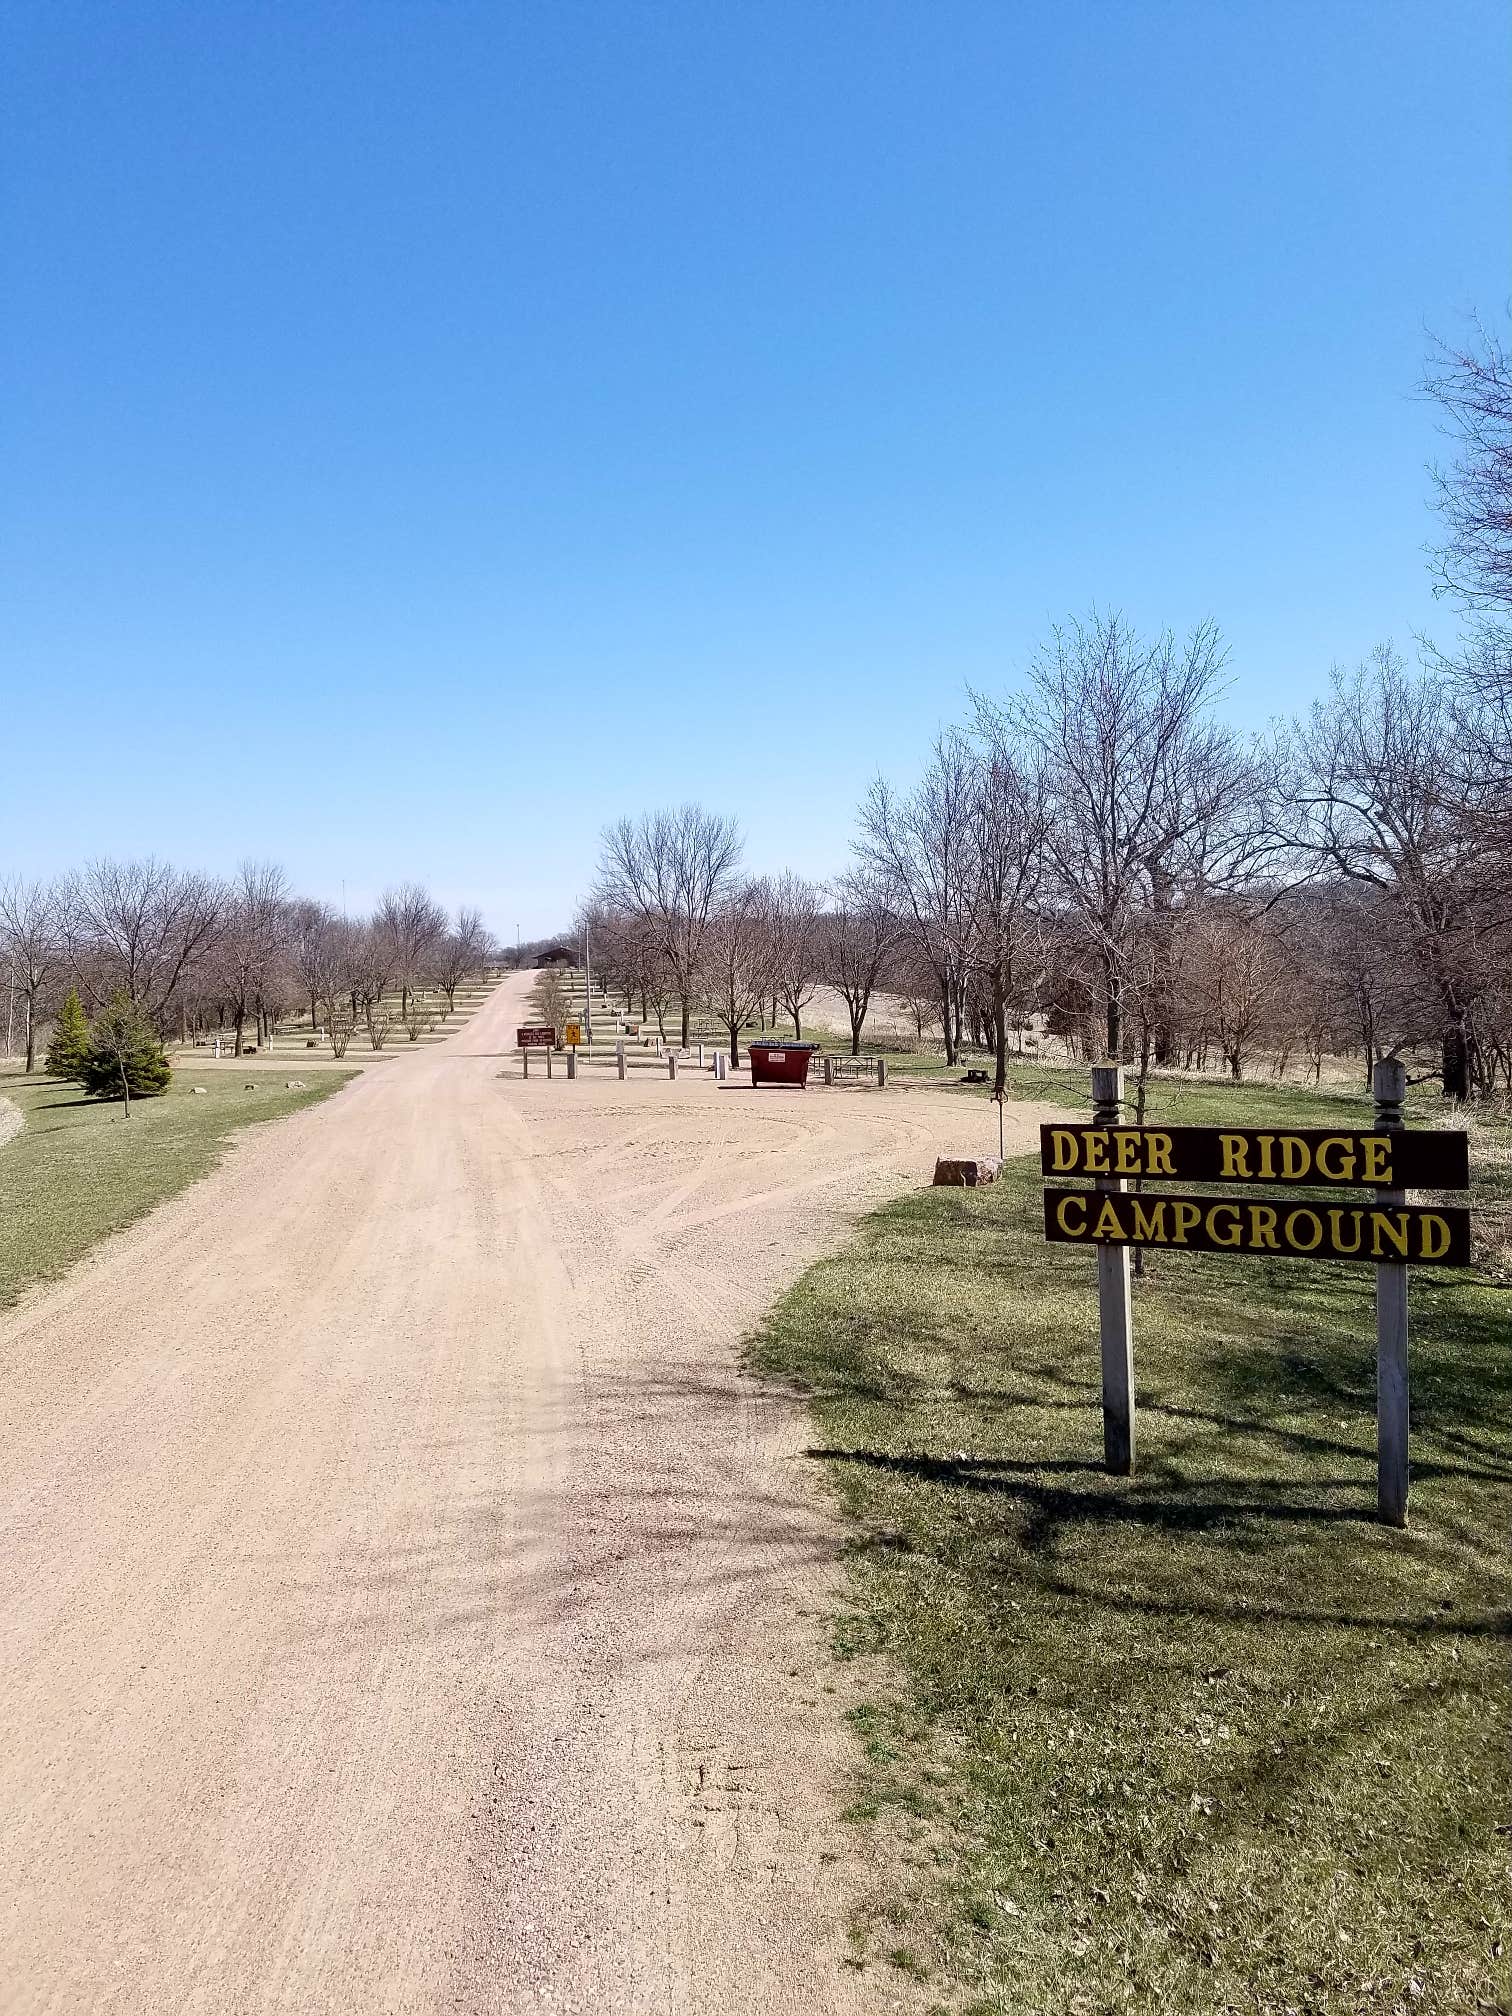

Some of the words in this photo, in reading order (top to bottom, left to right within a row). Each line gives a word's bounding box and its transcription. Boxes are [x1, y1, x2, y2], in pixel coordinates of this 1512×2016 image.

[1051, 1130, 1178, 1174] DEER
[1219, 1134, 1393, 1183] RIDGE
[1056, 1196, 1452, 1259] CAMPGROUND
